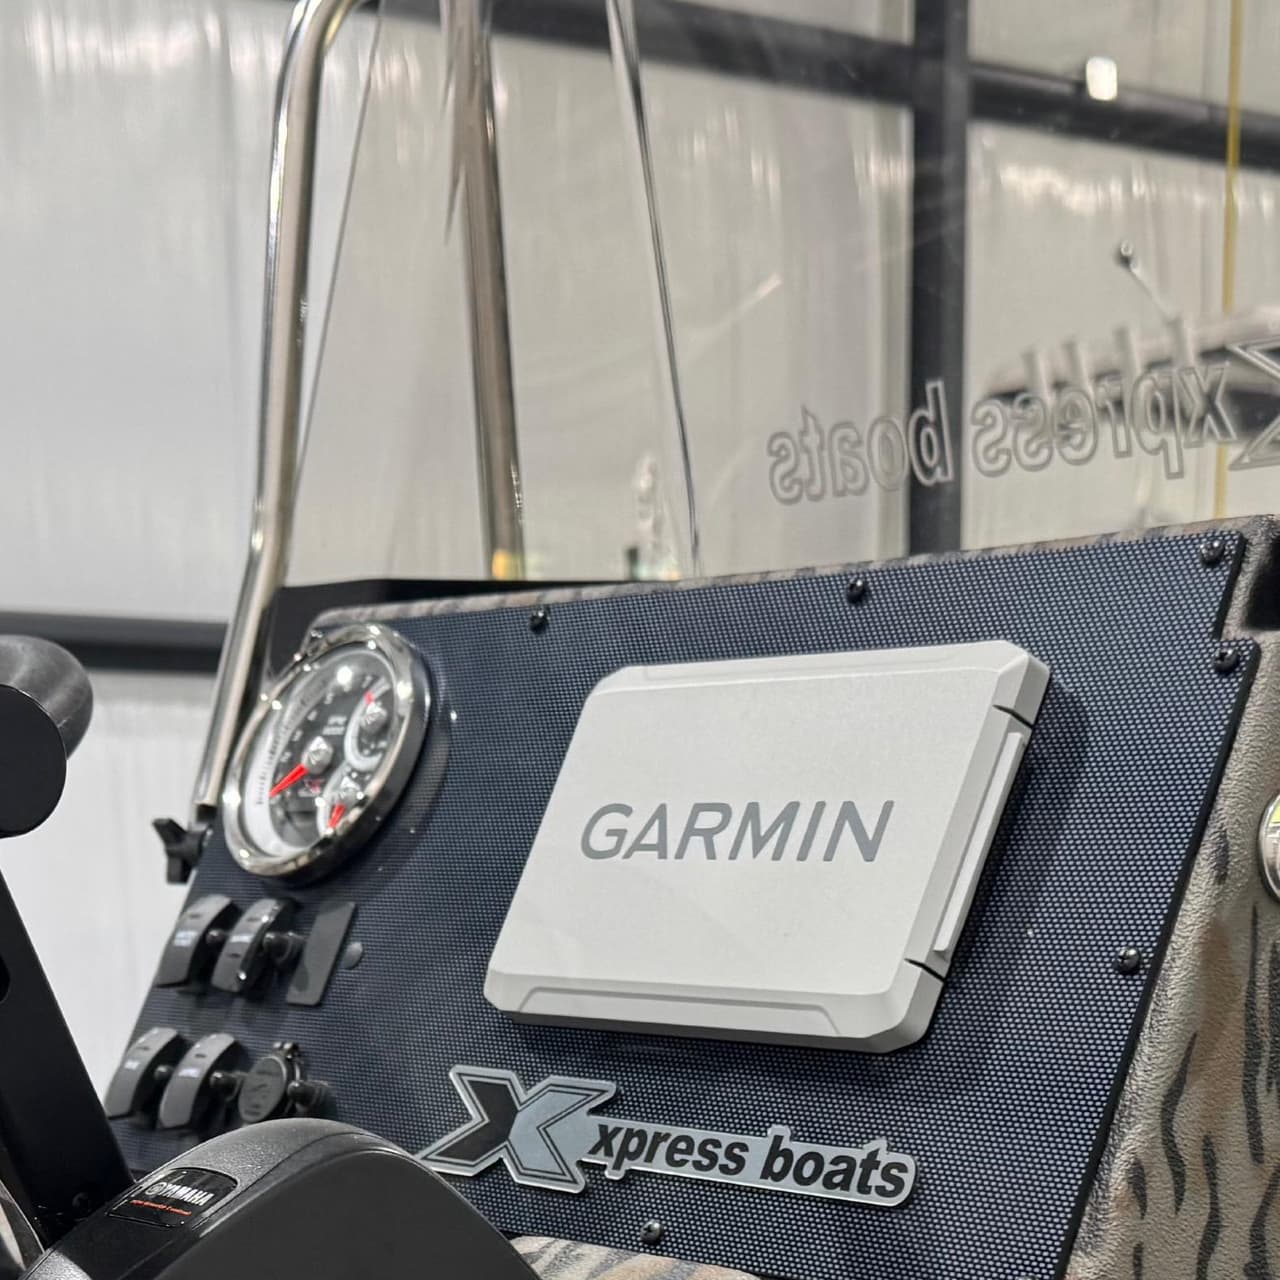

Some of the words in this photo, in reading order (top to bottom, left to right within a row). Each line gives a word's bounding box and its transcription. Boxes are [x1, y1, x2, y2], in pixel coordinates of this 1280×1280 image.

[580, 800, 895, 862] GARMIN
[587, 1123, 748, 1178] xpress
[760, 1136, 910, 1199] boats
